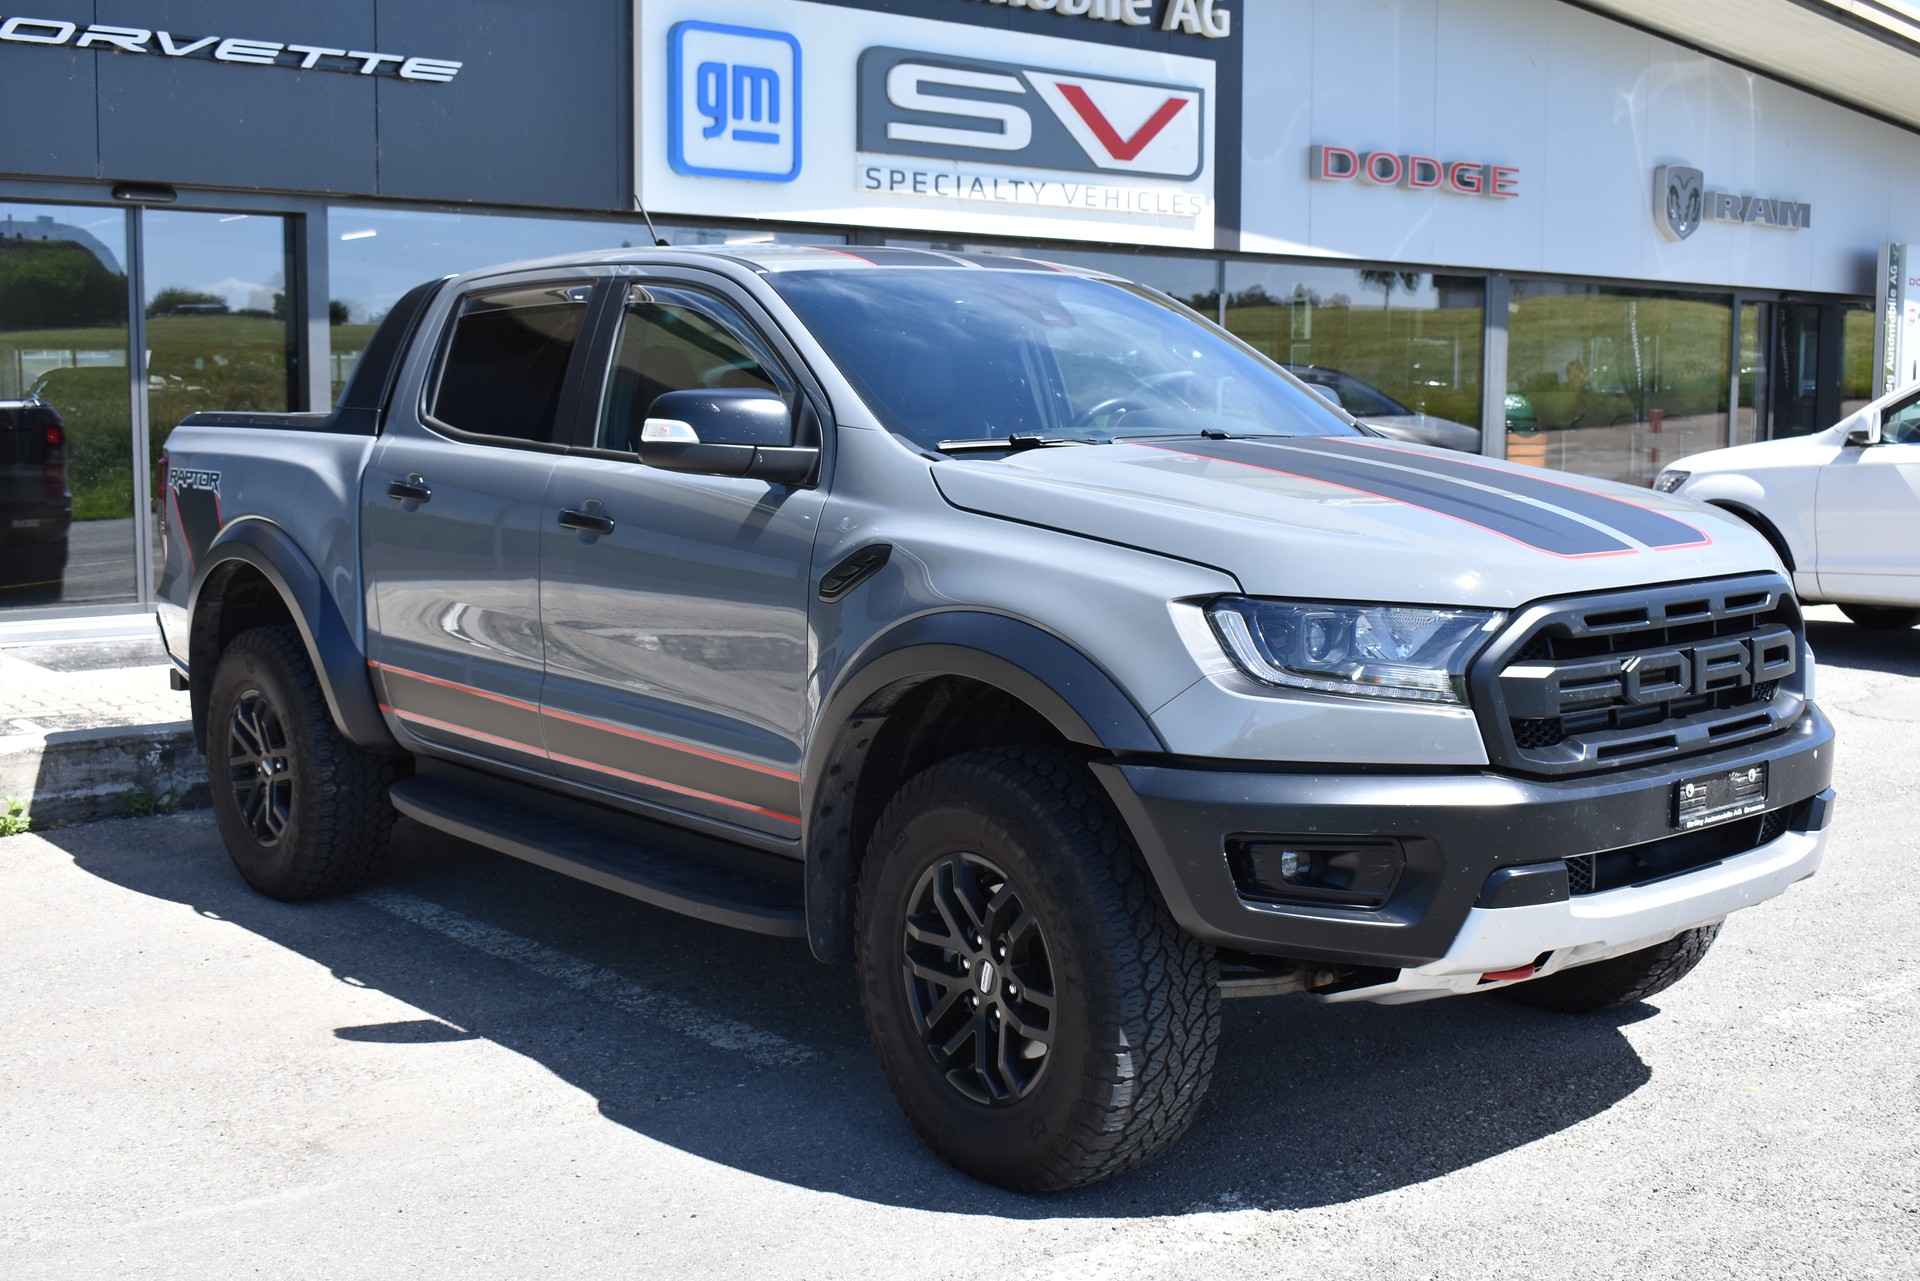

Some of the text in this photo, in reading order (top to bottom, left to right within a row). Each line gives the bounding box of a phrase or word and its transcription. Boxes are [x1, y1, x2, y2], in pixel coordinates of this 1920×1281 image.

[1162, 0, 1231, 38] AG
[697, 62, 780, 144] gm
[887, 63, 1189, 161] SV
[865, 167, 1202, 216] SPECIALTY VEHICLES
[1320, 145, 1521, 199] DODGE
[1714, 191, 1812, 230] RAM
[1889, 264, 1898, 285] AG
[1885, 289, 1897, 371] Automobile
[169, 466, 222, 500] RAPTOR
[1500, 624, 1797, 719] FORD
